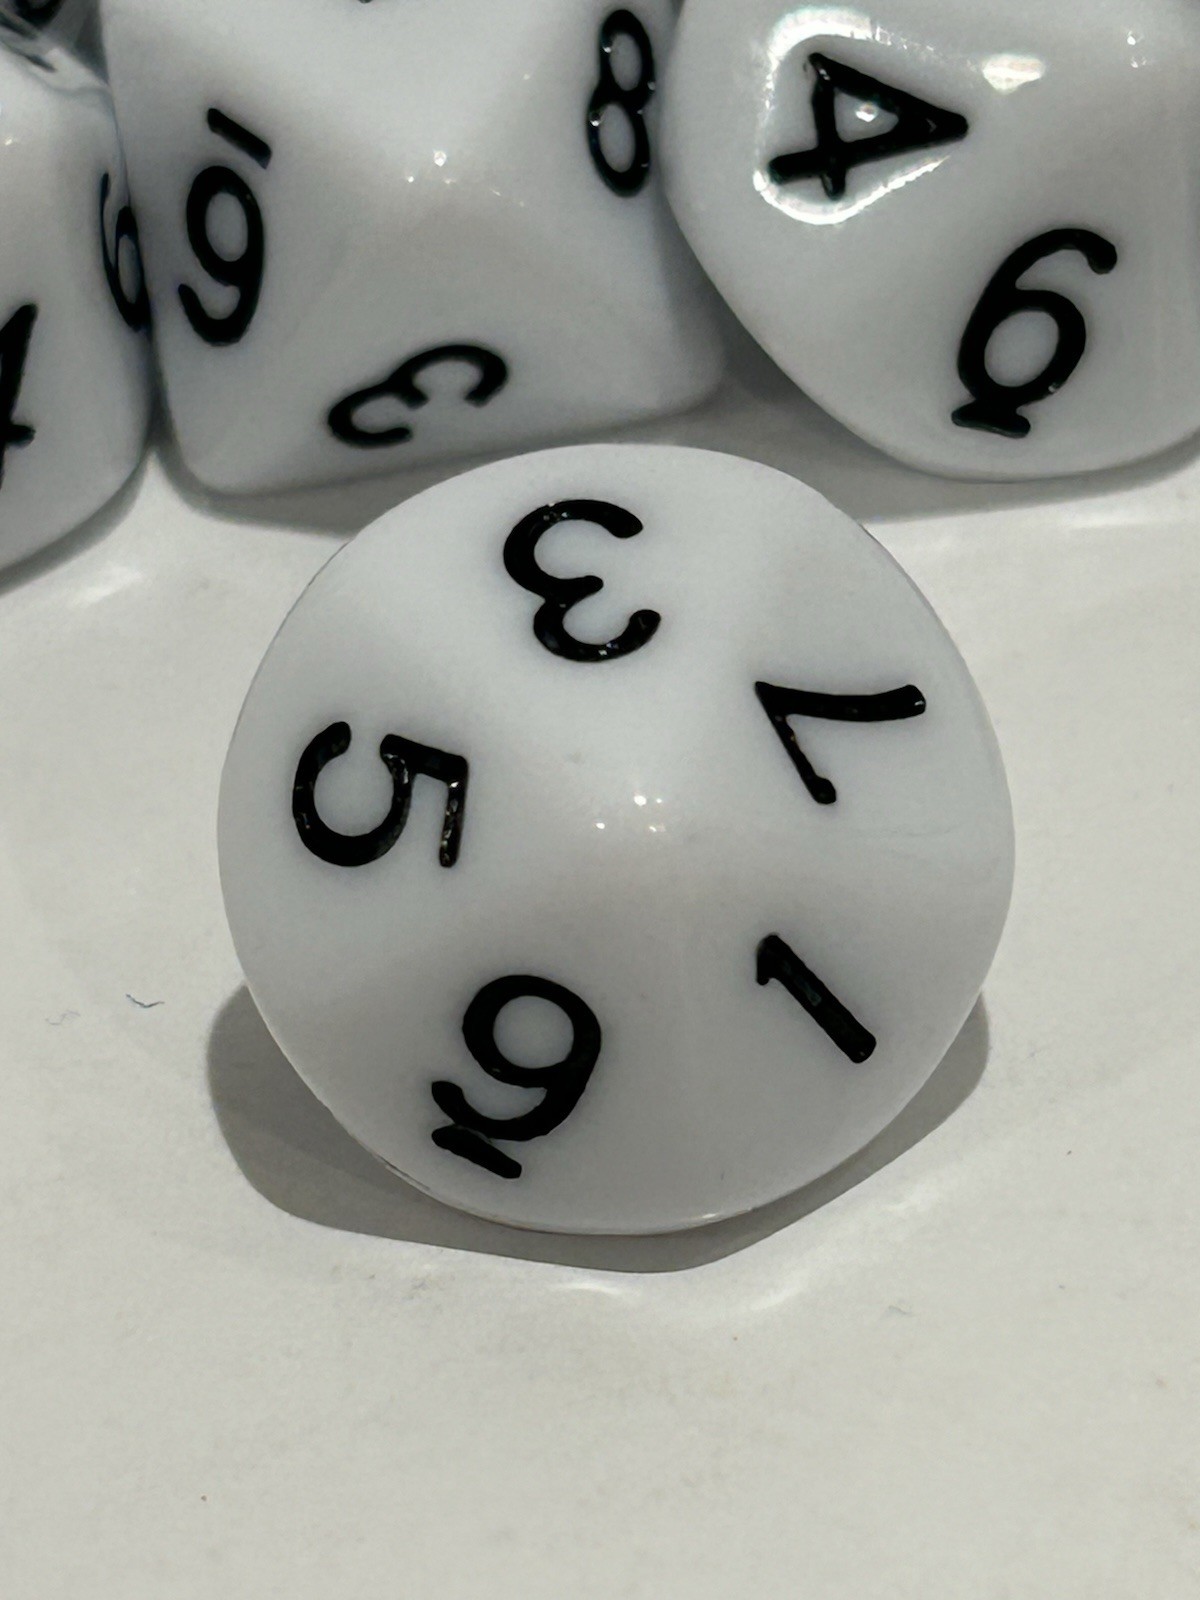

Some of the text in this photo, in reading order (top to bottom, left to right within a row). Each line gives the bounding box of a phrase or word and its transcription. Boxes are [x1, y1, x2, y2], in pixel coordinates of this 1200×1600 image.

[585, 8, 655, 196] 8
[768, 52, 968, 200] 4
[325, 341, 509, 448] 3
[951, 227, 1118, 438] 6
[502, 498, 662, 663] 3
[292, 720, 470, 868] 5
[754, 680, 927, 805] 7
[755, 933, 876, 1064] 1
[430, 973, 603, 1180] 9
